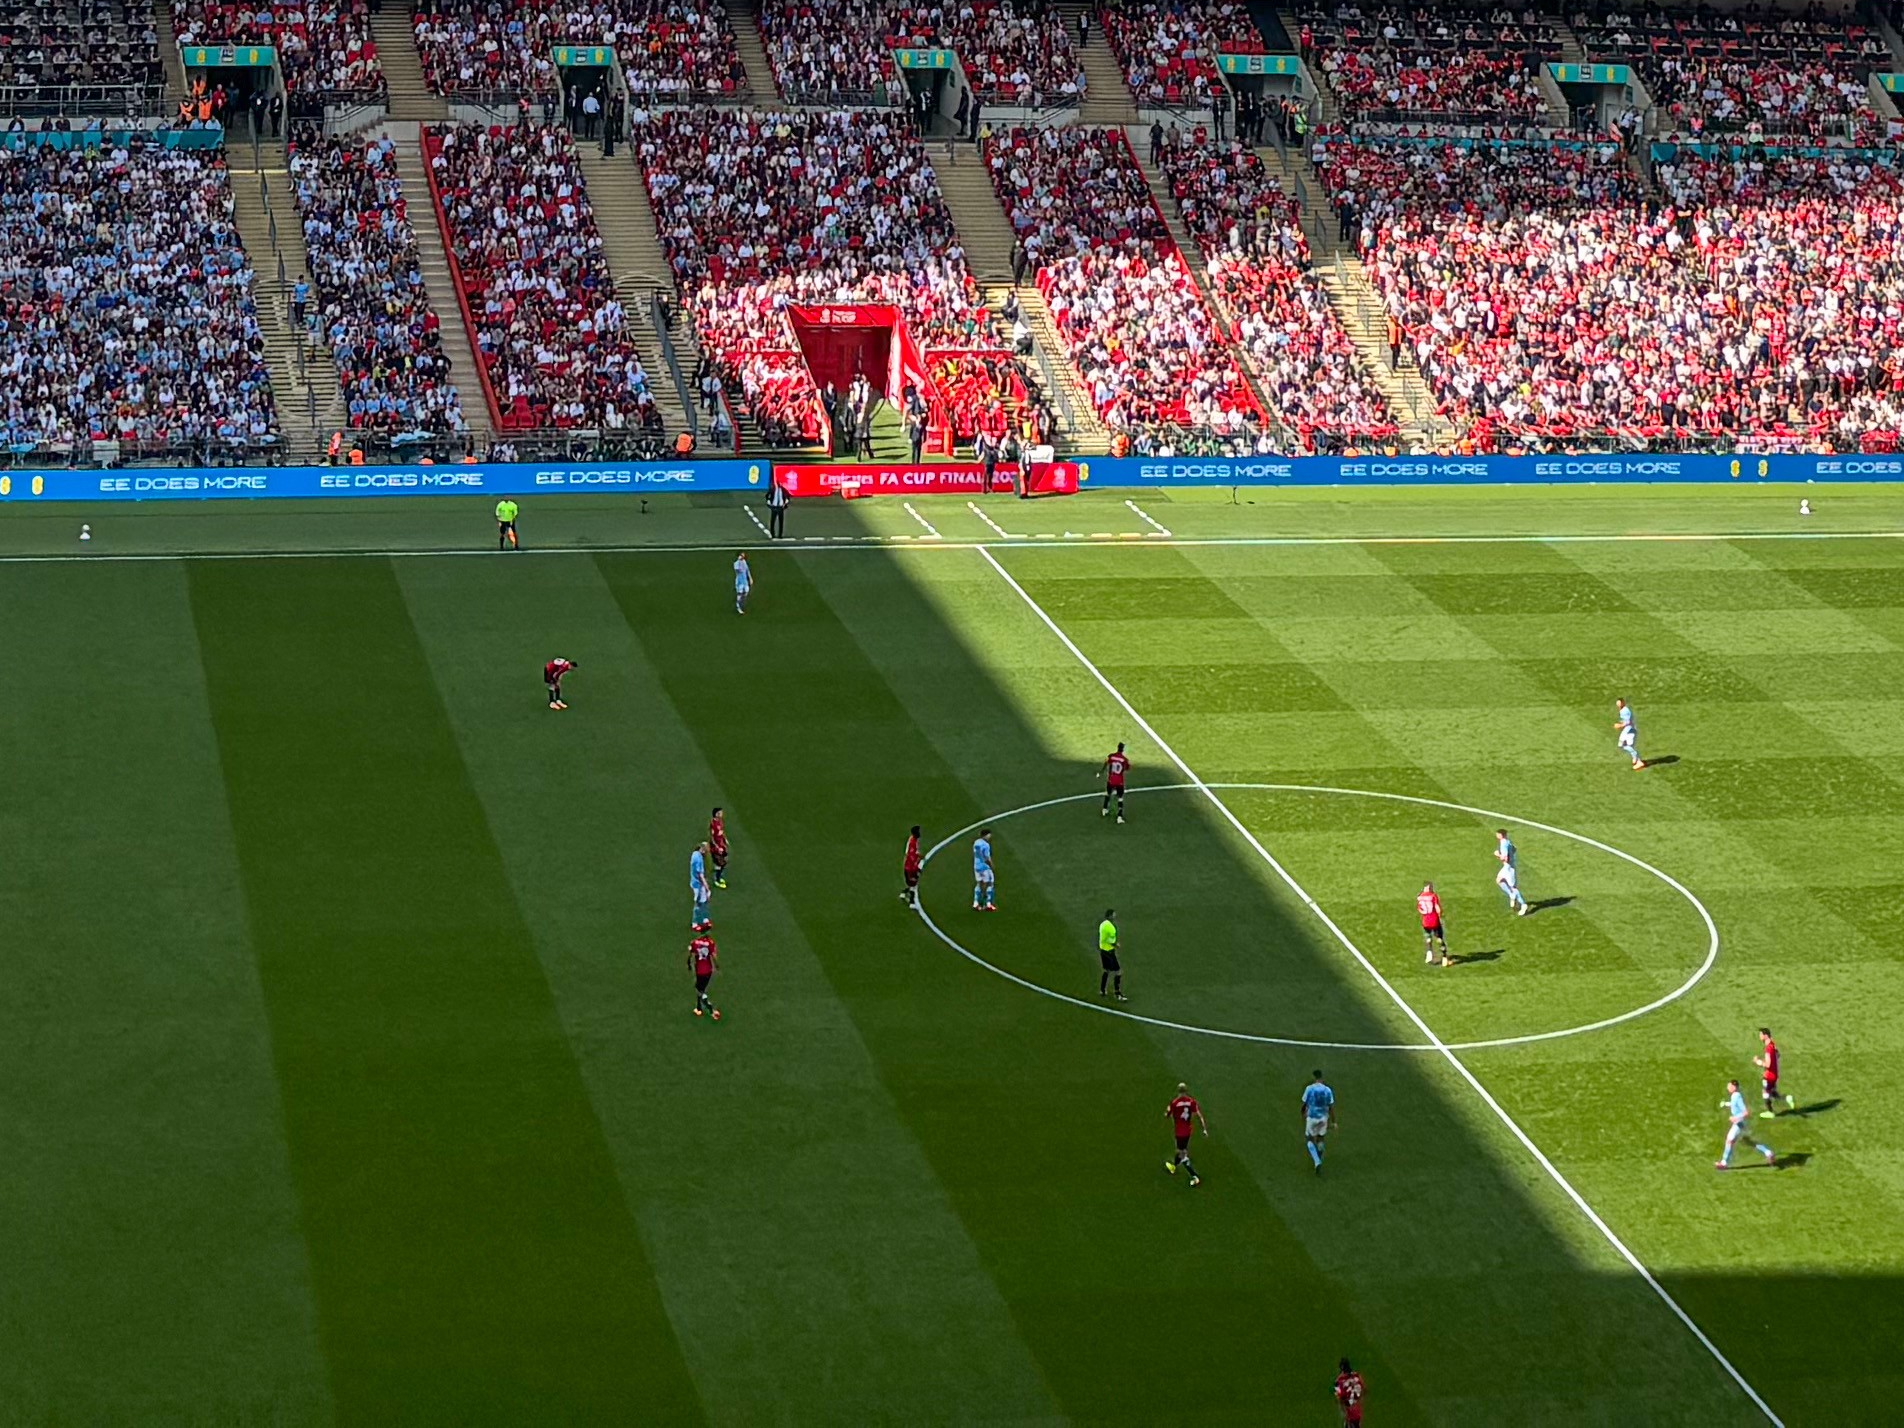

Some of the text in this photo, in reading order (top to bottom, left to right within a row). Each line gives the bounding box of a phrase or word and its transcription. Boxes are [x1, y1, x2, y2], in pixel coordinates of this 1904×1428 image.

[1140, 464, 1292, 478] EE DOES MORE
[1340, 463, 1488, 476] EE DOES MORE
[1535, 462, 1681, 475] EE DOES MORE
[1816, 462, 1842, 473] EE
[1846, 461, 1902, 473] DOES
[99, 476, 267, 491] EE DOES MORE
[320, 473, 484, 488] EE DOES MORE
[535, 470, 695, 484] EE DOES MORE
[879, 472, 899, 485] FA
[902, 472, 934, 485] CUP
[940, 471, 984, 484] FINAL
